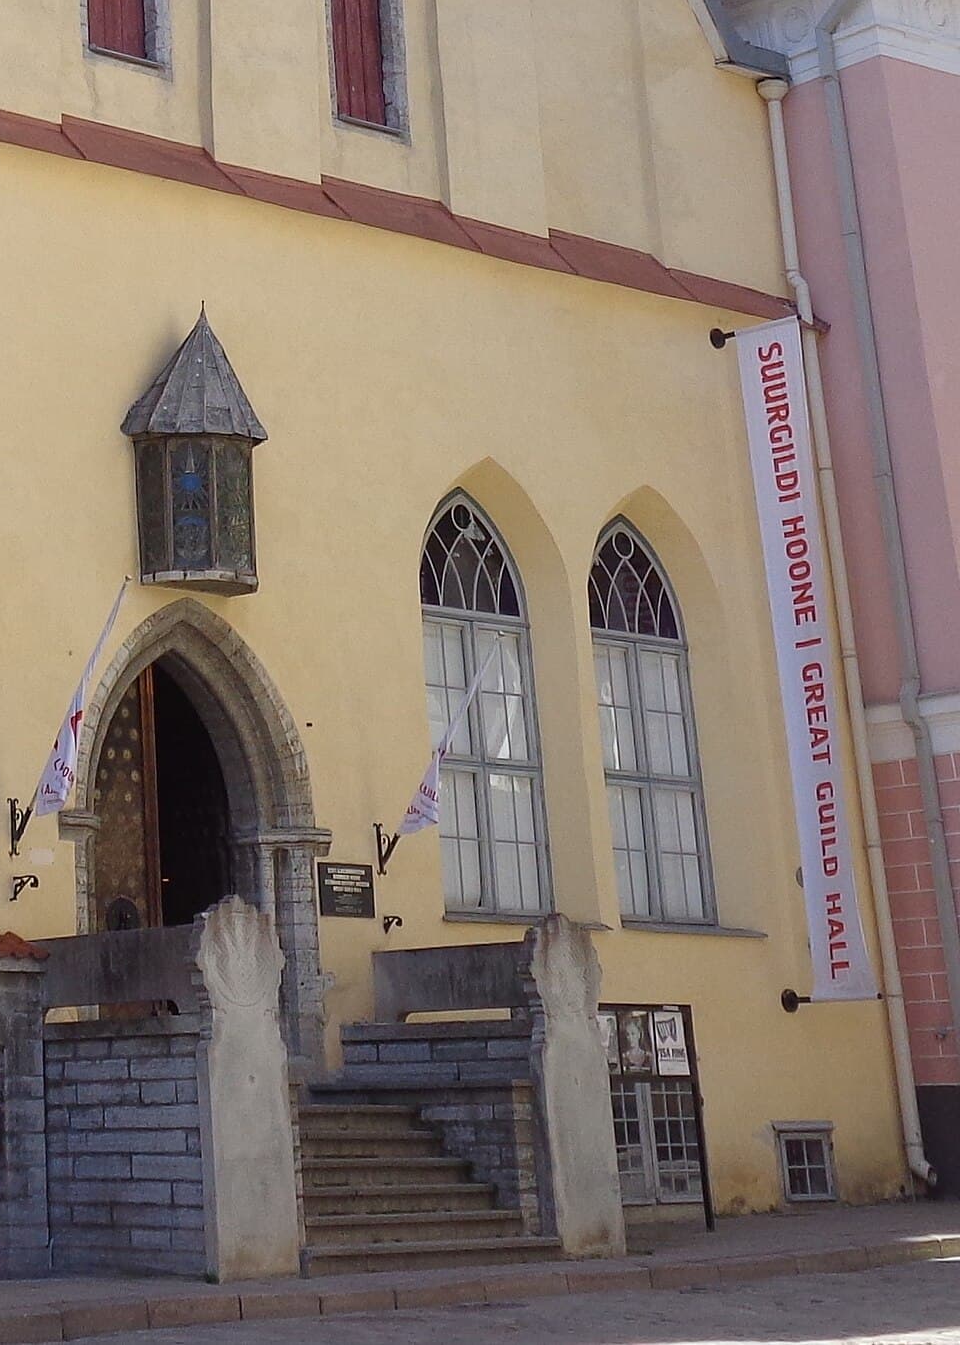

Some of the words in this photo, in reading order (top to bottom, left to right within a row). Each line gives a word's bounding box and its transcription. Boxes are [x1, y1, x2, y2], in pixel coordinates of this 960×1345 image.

[757, 341, 801, 503] SUURGILDI
[781, 515, 817, 627] HOONE
[802, 662, 832, 765] GREAT
[816, 781, 838, 878] GUILD
[826, 893, 850, 980] HALL
